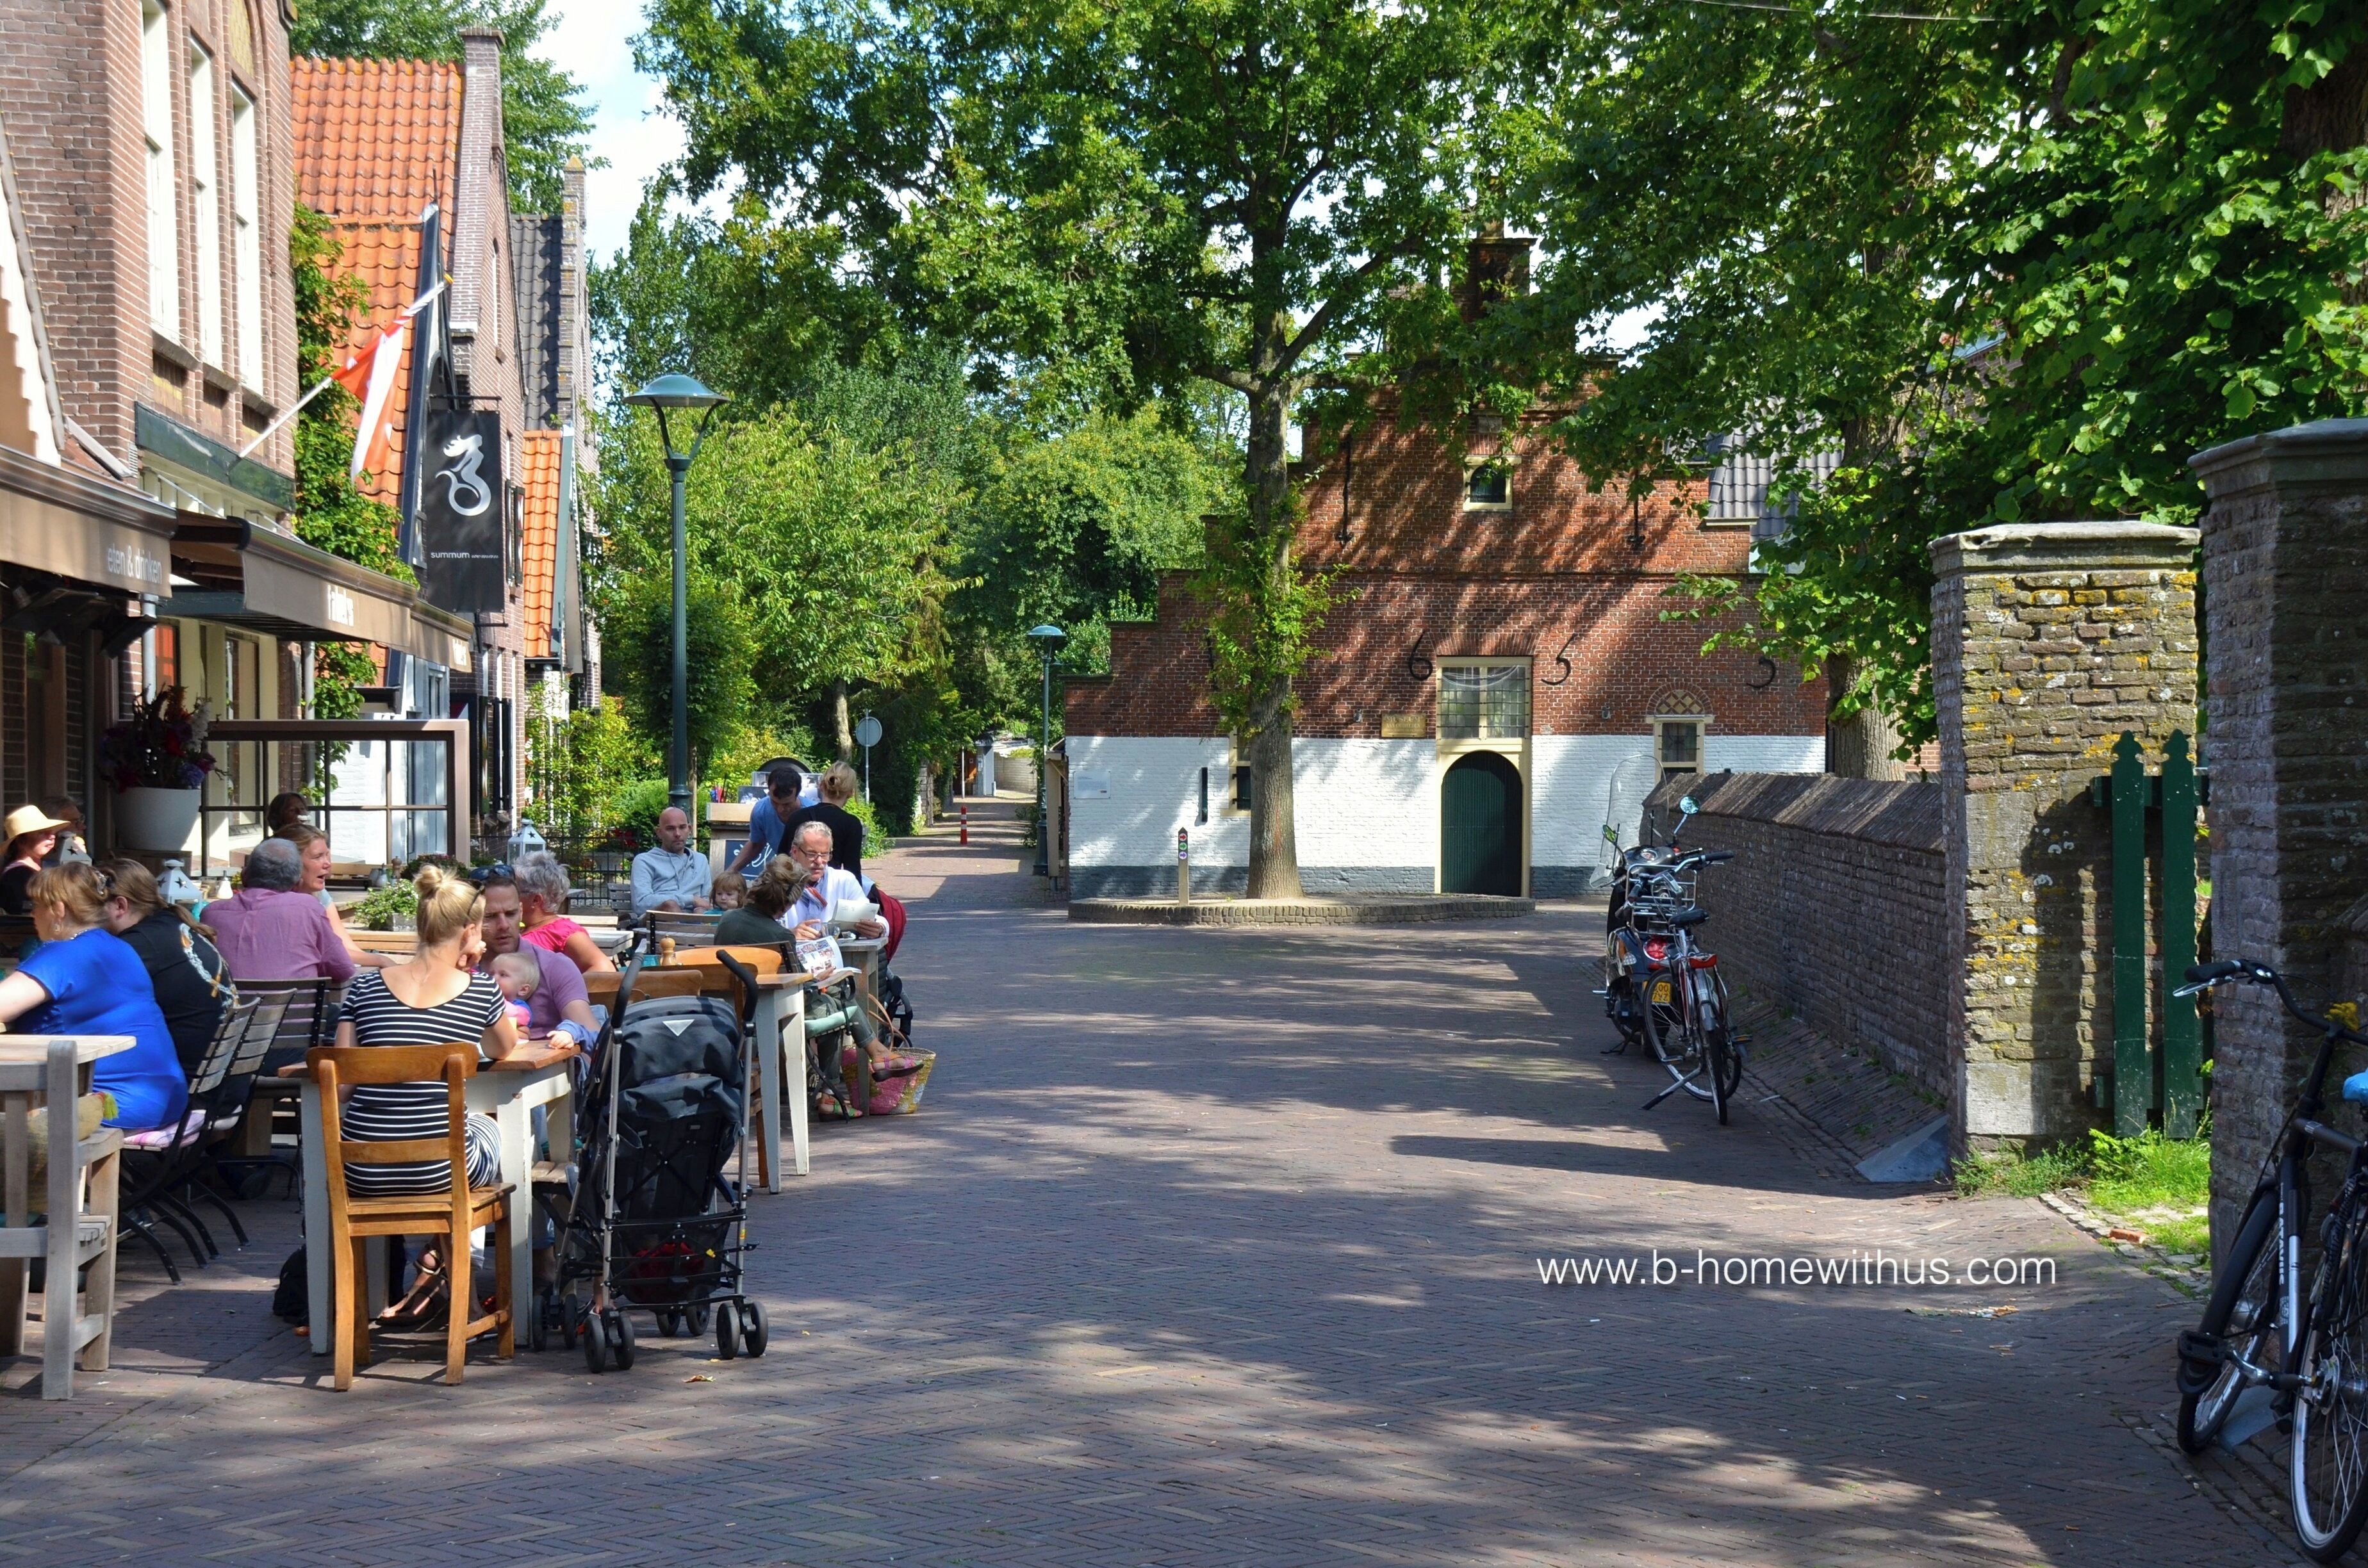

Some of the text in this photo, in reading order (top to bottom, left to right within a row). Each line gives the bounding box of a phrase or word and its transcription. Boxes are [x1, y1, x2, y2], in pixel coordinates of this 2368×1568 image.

[107, 543, 162, 584] eten & drinken
